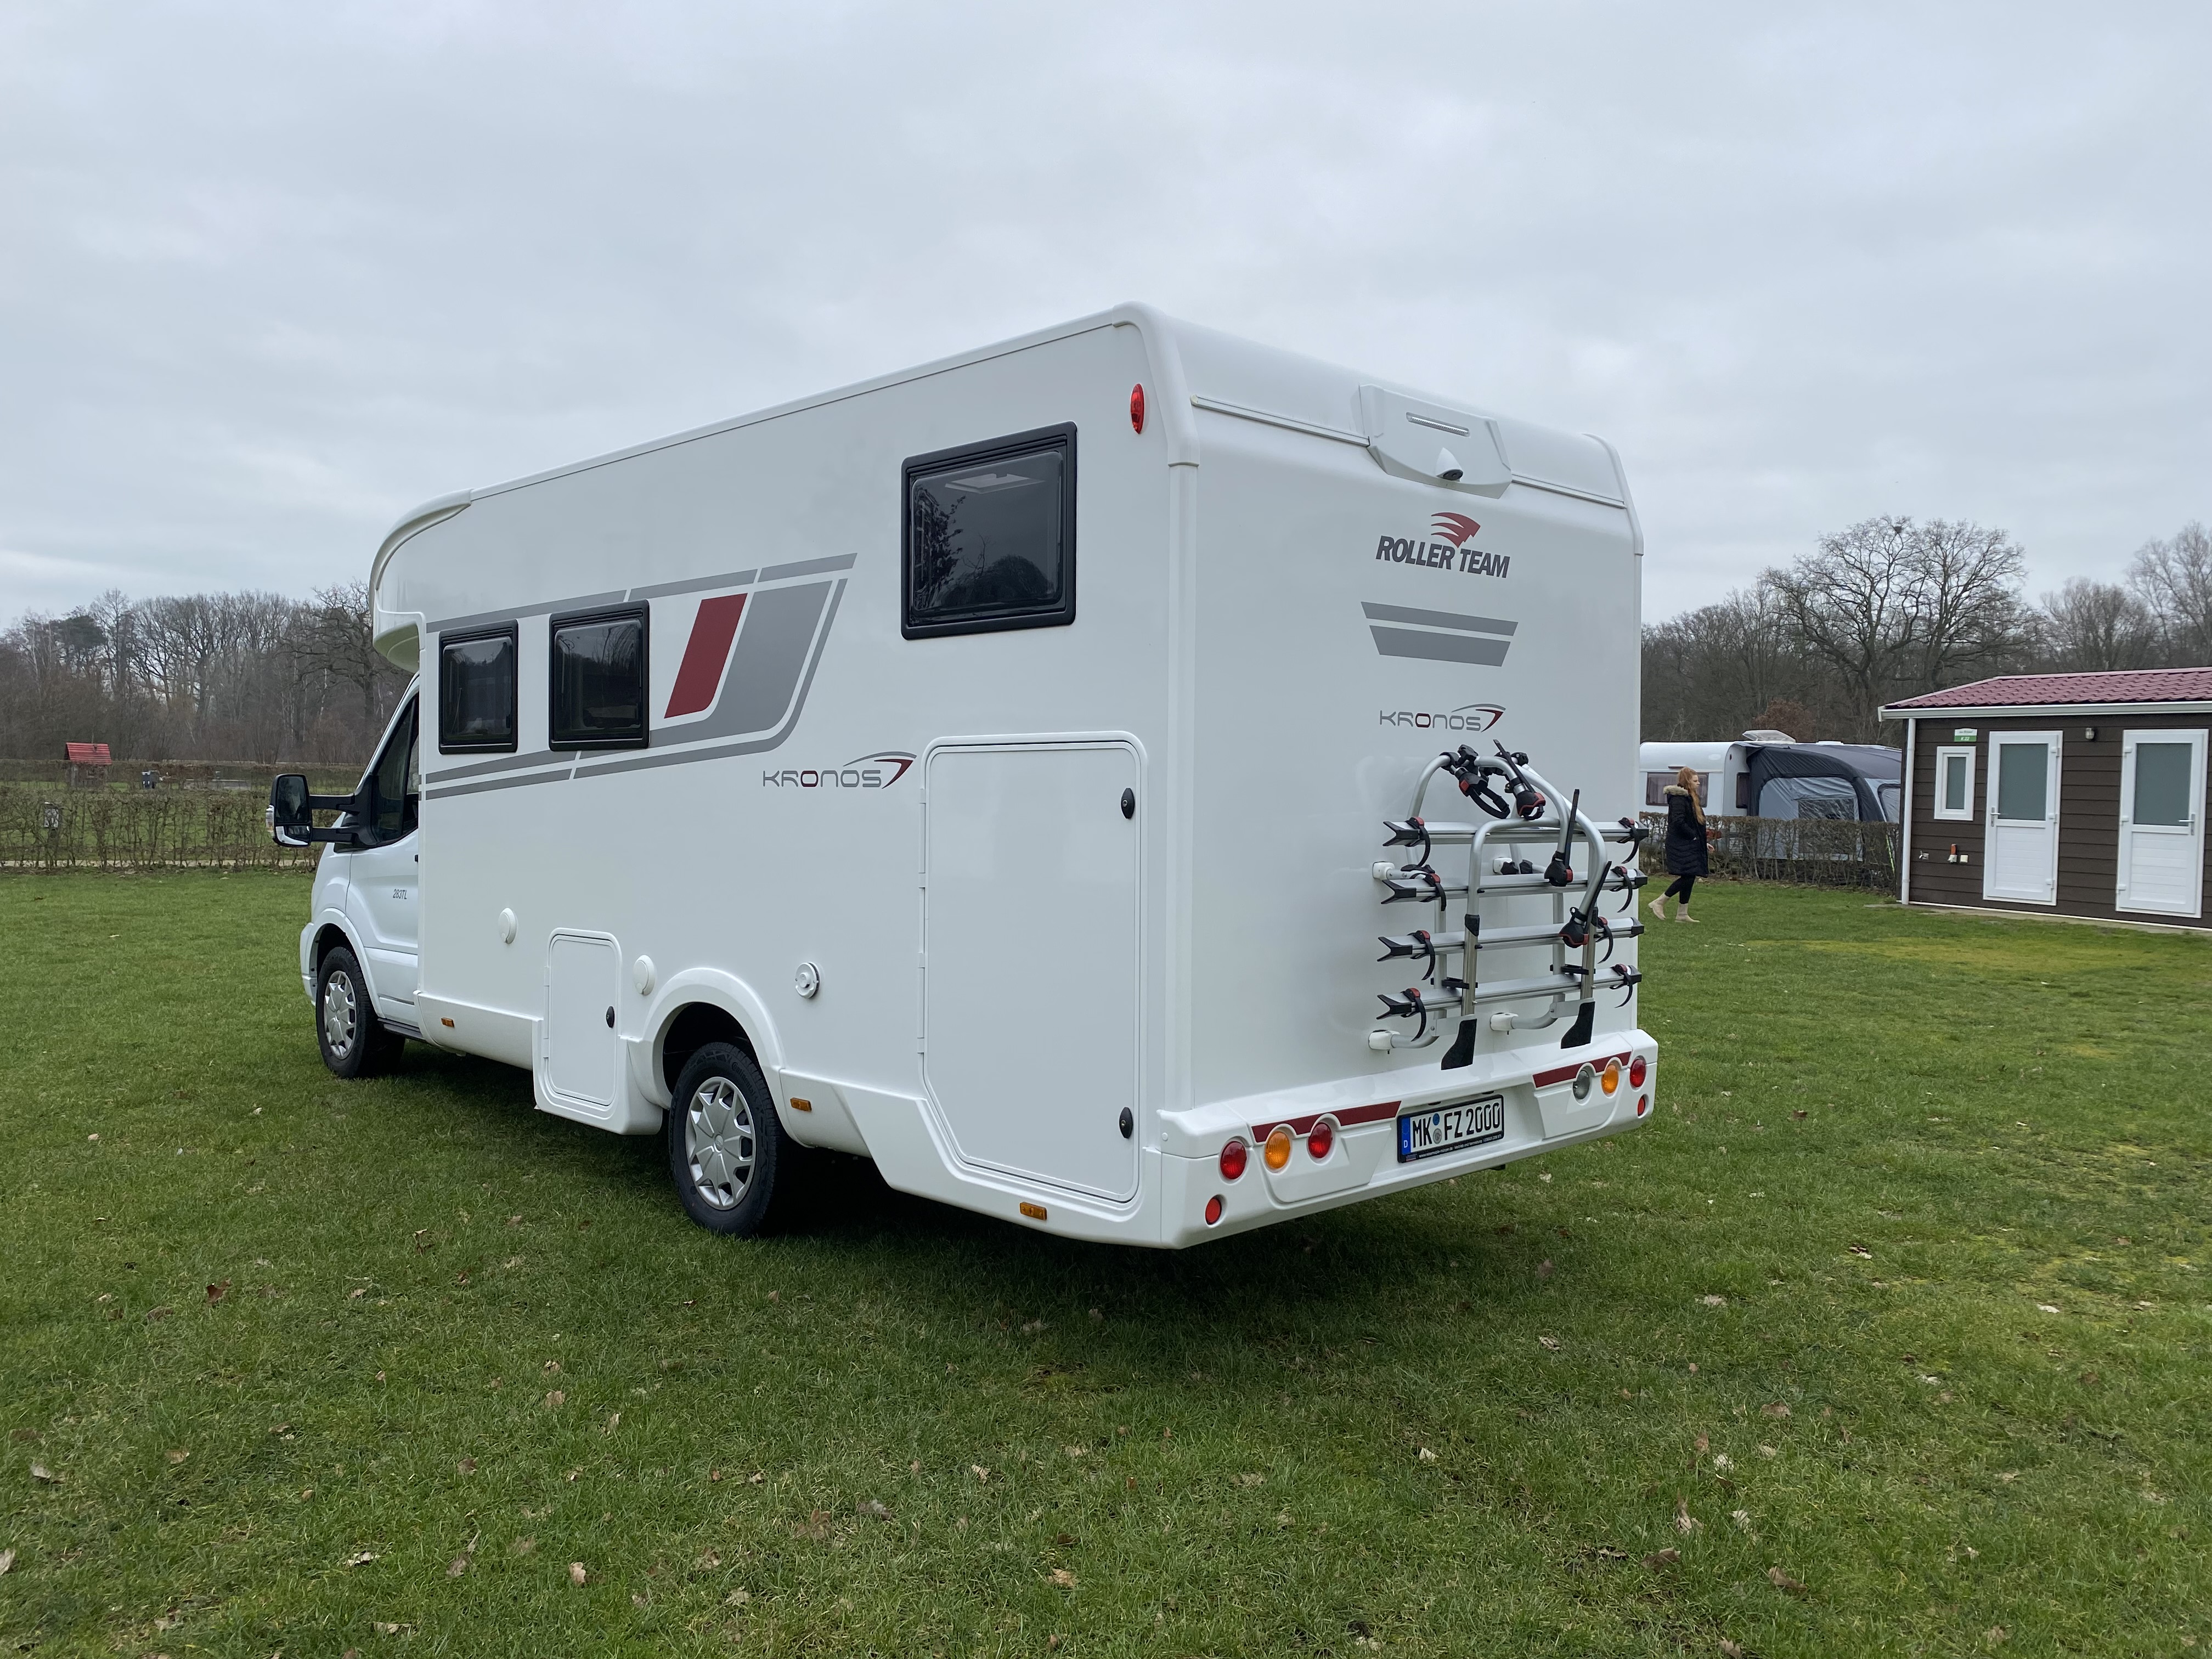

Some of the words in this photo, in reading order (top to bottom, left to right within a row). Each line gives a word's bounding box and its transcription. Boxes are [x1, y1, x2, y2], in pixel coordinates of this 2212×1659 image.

[1375, 535, 1455, 570] ROLLER
[1459, 548, 1511, 578] TEAM
[1379, 709, 1481, 731] KRONOS
[763, 770, 882, 788] KRONOS
[392, 888, 407, 900] 283TL
[1412, 1116, 1432, 1148] MK
[1444, 1110, 1463, 1141] FZ
[1466, 1102, 1500, 1136] 2000
[1403, 1139, 1408, 1148] D
